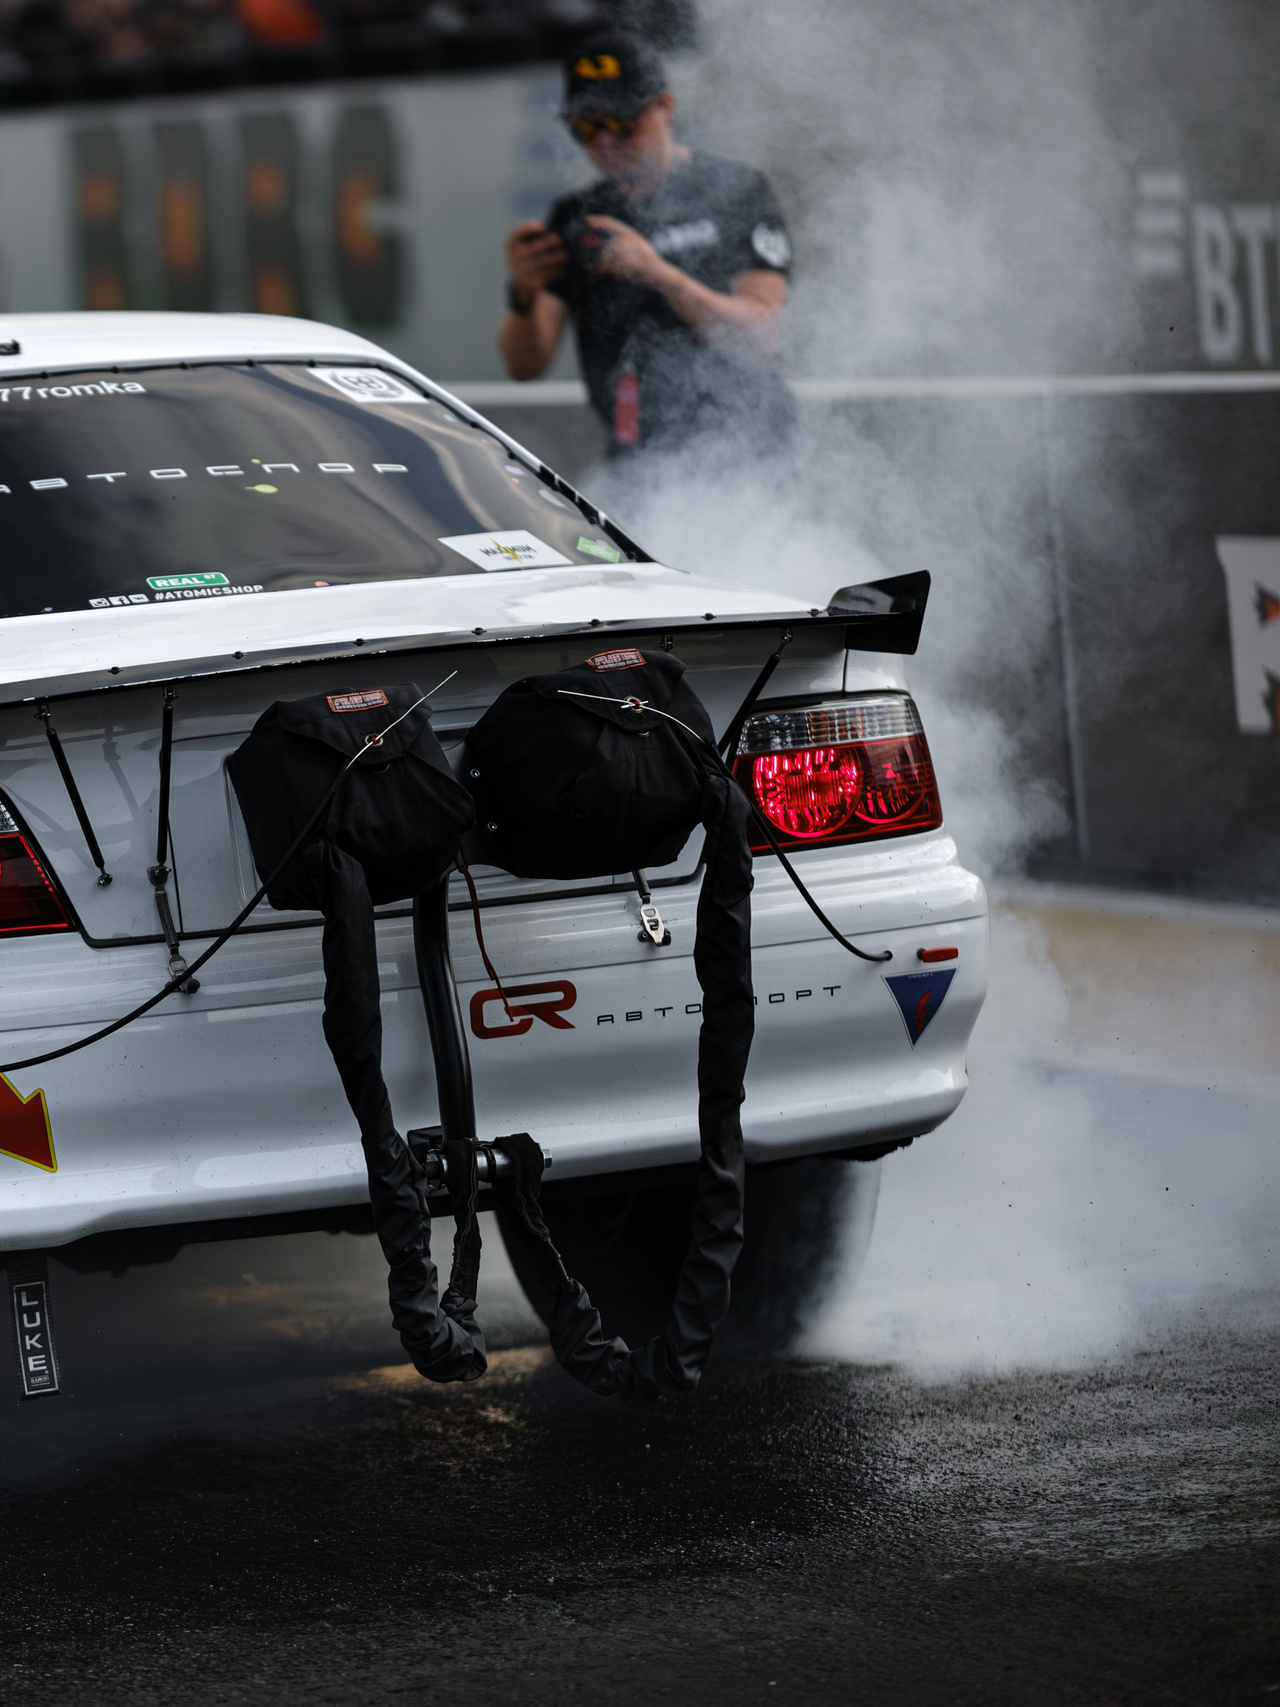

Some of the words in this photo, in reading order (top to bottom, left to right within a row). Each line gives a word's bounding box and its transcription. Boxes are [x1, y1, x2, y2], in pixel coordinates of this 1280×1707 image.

[154, 577, 206, 588] REAL
[154, 584, 264, 602] #ATOMICSHOP
[597, 985, 842, 1026] АВТООРТ
[20, 1291, 48, 1372] LUKE
